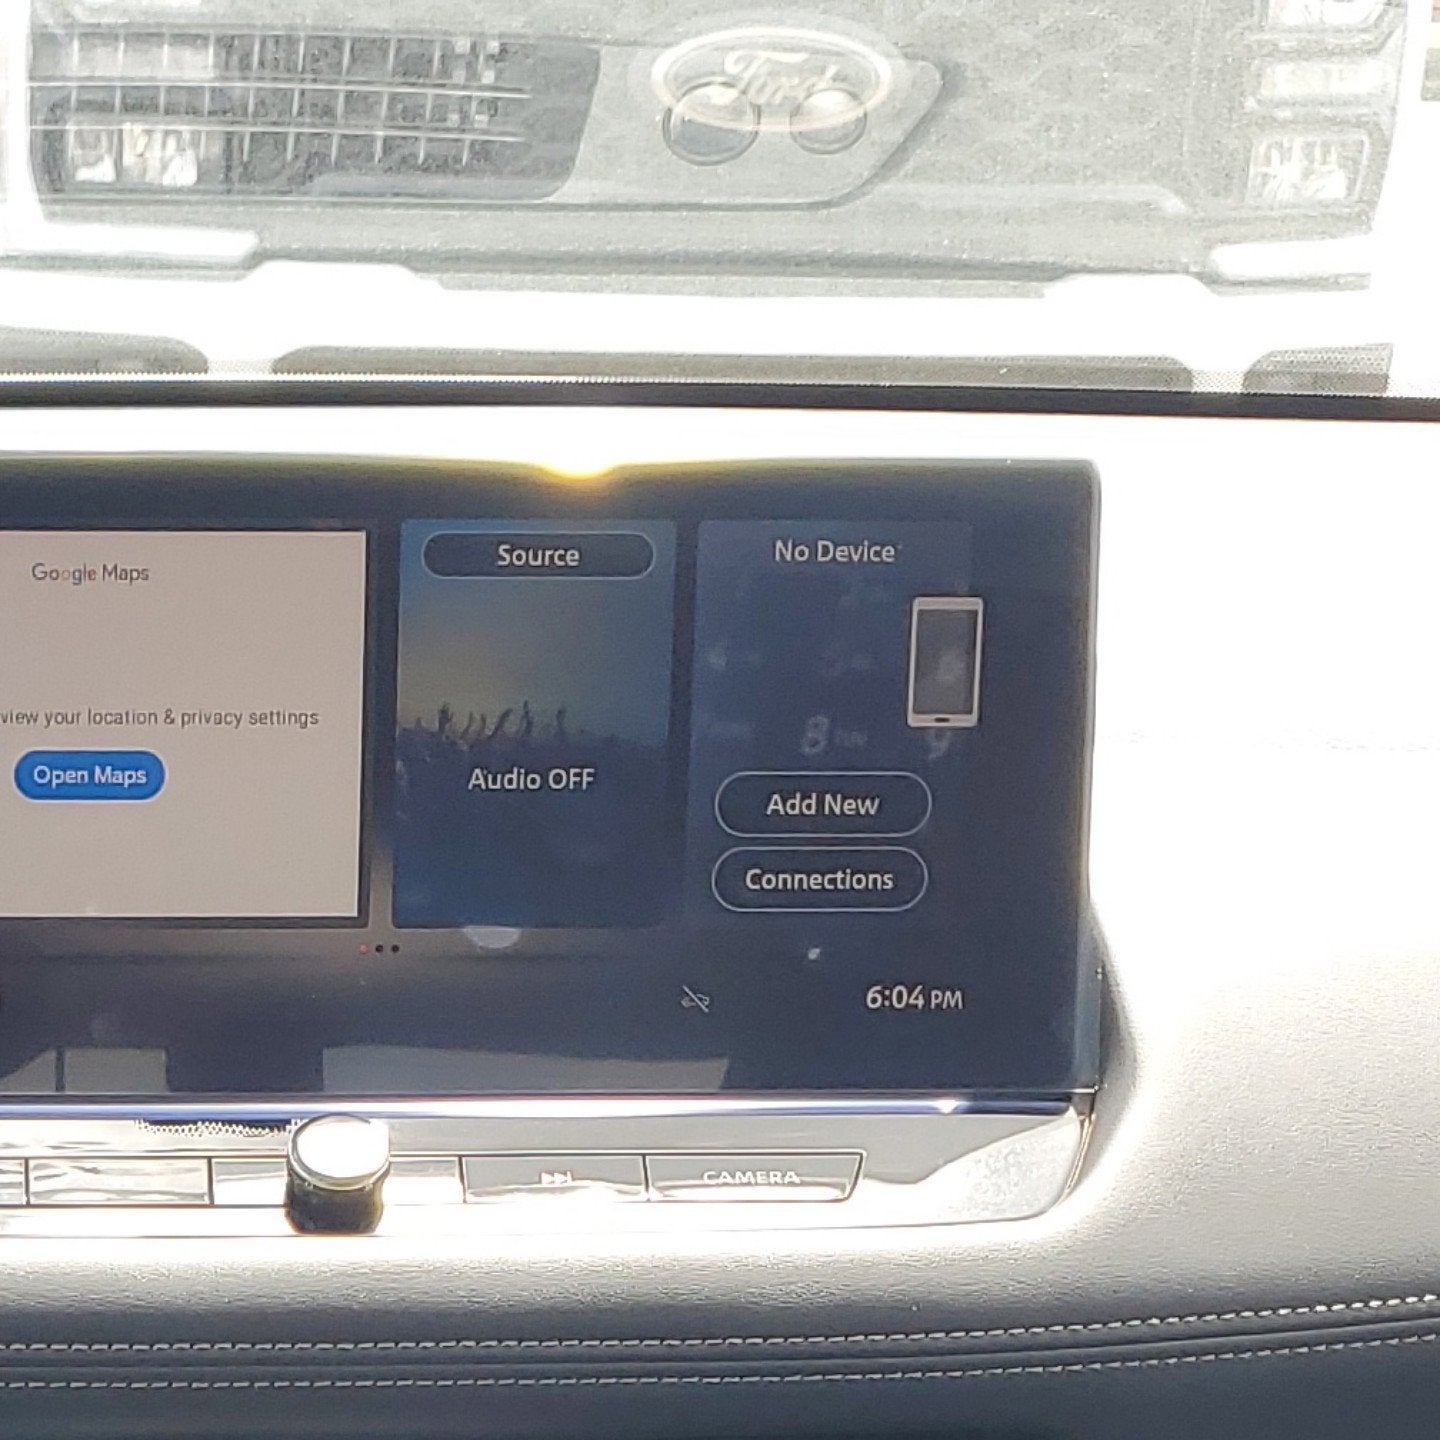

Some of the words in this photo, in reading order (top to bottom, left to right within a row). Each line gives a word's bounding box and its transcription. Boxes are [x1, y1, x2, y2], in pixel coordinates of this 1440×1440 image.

[498, 544, 579, 566] Source
[774, 541, 808, 563] No
[815, 541, 895, 563] Device
[32, 563, 97, 585] Google
[103, 564, 149, 585] Maps
[43, 711, 82, 730] your
[87, 708, 158, 726] location
[163, 708, 176, 726] &
[180, 708, 243, 730] privacy
[248, 708, 319, 730] settings
[33, 765, 89, 788] Open
[95, 765, 146, 788] Maps
[468, 768, 541, 791] Audio
[548, 769, 596, 790] OFF
[766, 793, 818, 816] Add
[824, 795, 879, 816] New
[745, 868, 894, 892] Connections
[866, 986, 924, 1010] 6:04
[930, 990, 962, 1009] PM
[703, 1169, 801, 1186] CAMERA
